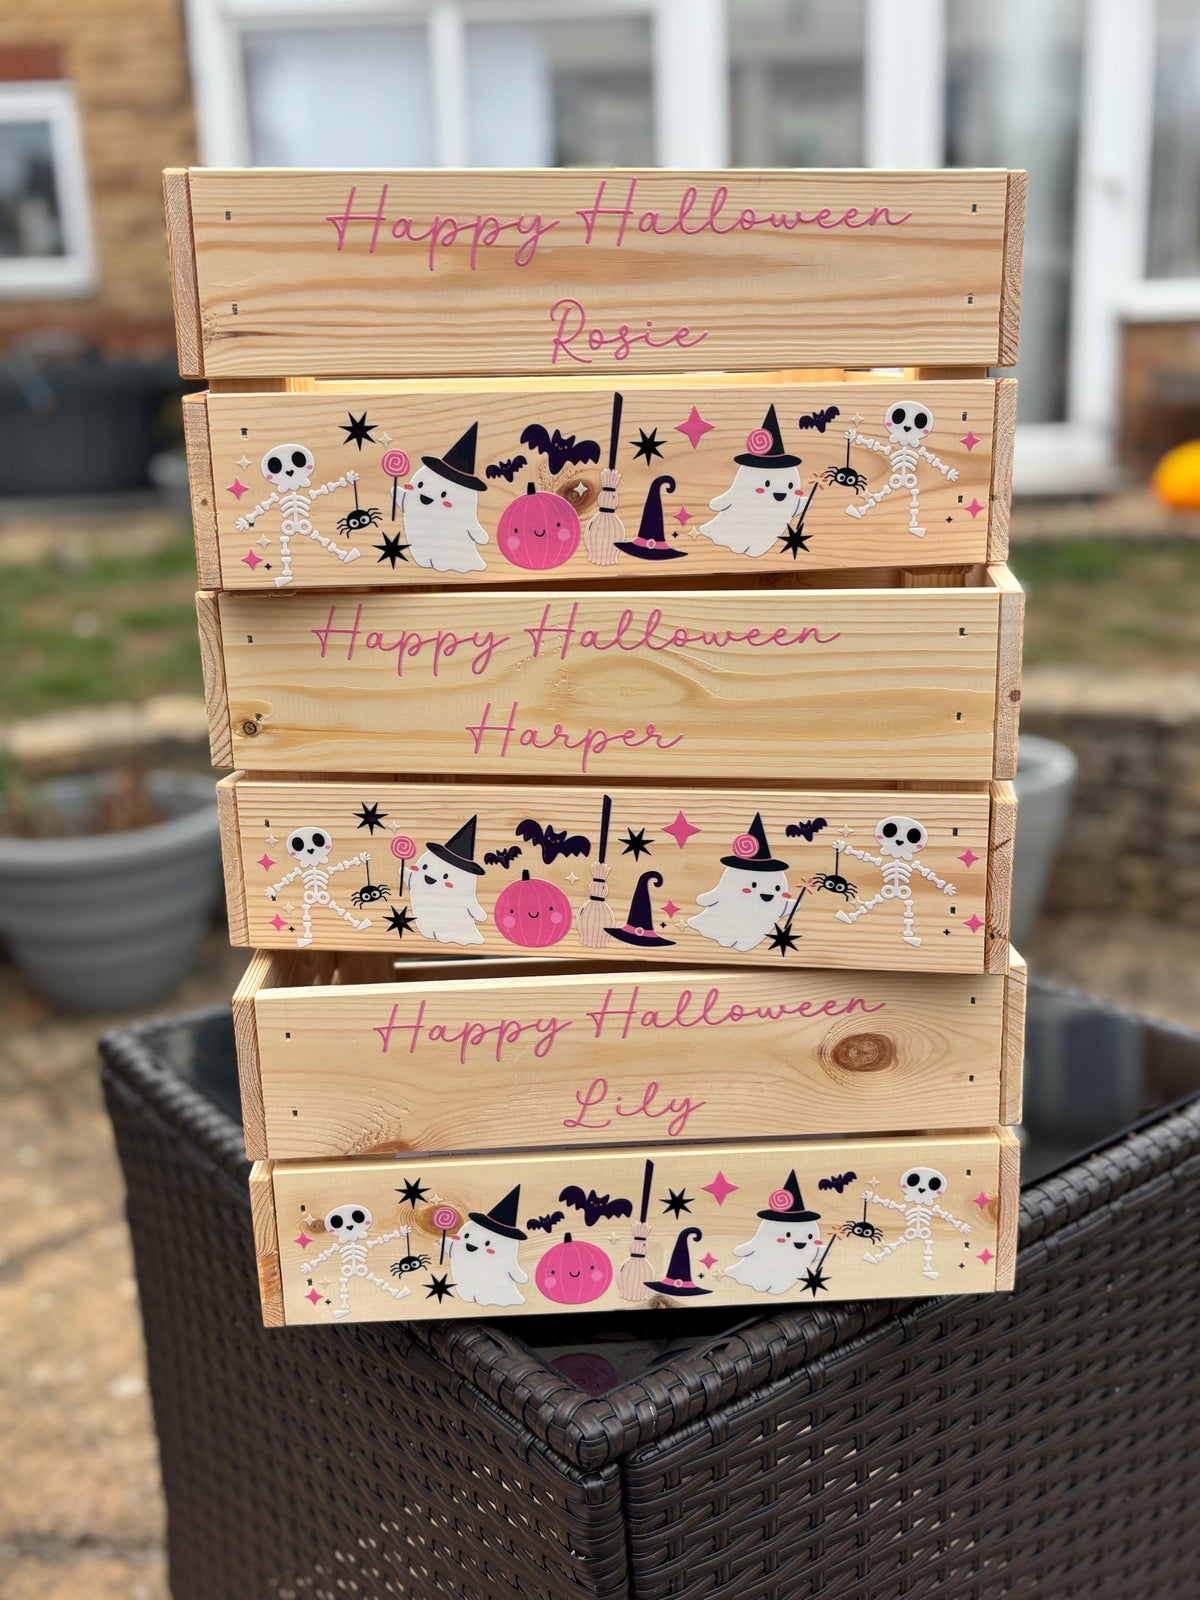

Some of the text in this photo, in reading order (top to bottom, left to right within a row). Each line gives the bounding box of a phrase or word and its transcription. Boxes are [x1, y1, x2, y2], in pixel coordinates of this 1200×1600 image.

[326, 177, 912, 271] Happy Halloween
[550, 298, 708, 364] Rosie
[311, 602, 841, 677] Happy Halloween
[465, 701, 683, 773] Harper
[373, 986, 886, 1065] Happy Halloween
[563, 1077, 706, 1137] Lily
